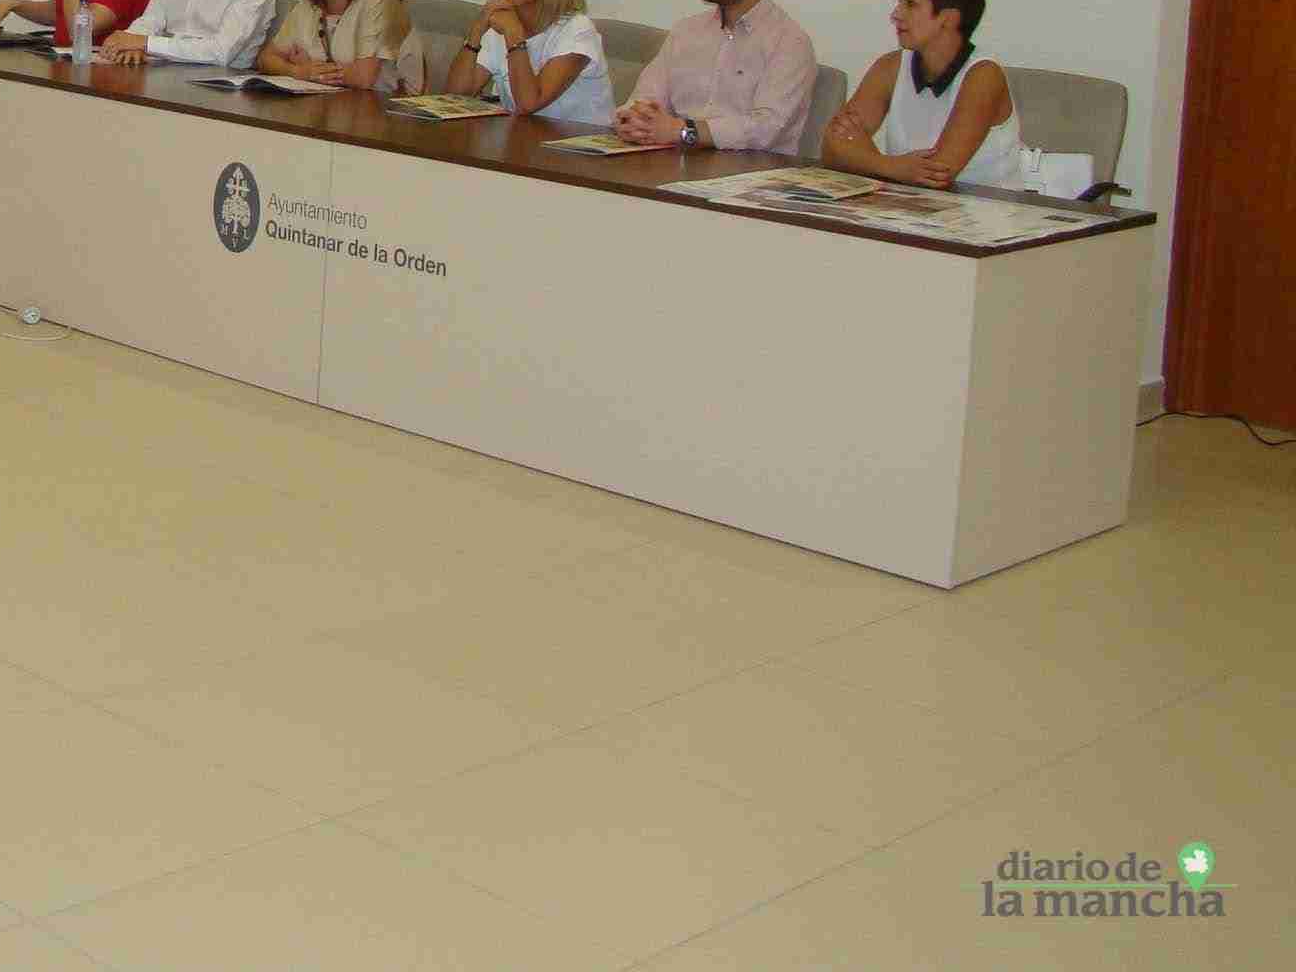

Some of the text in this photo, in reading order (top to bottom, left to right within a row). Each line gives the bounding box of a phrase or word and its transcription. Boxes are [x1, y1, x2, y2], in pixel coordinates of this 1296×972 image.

[267, 193, 367, 230] Ayuntamiento
[266, 220, 446, 277] Quintanar de la Orden
